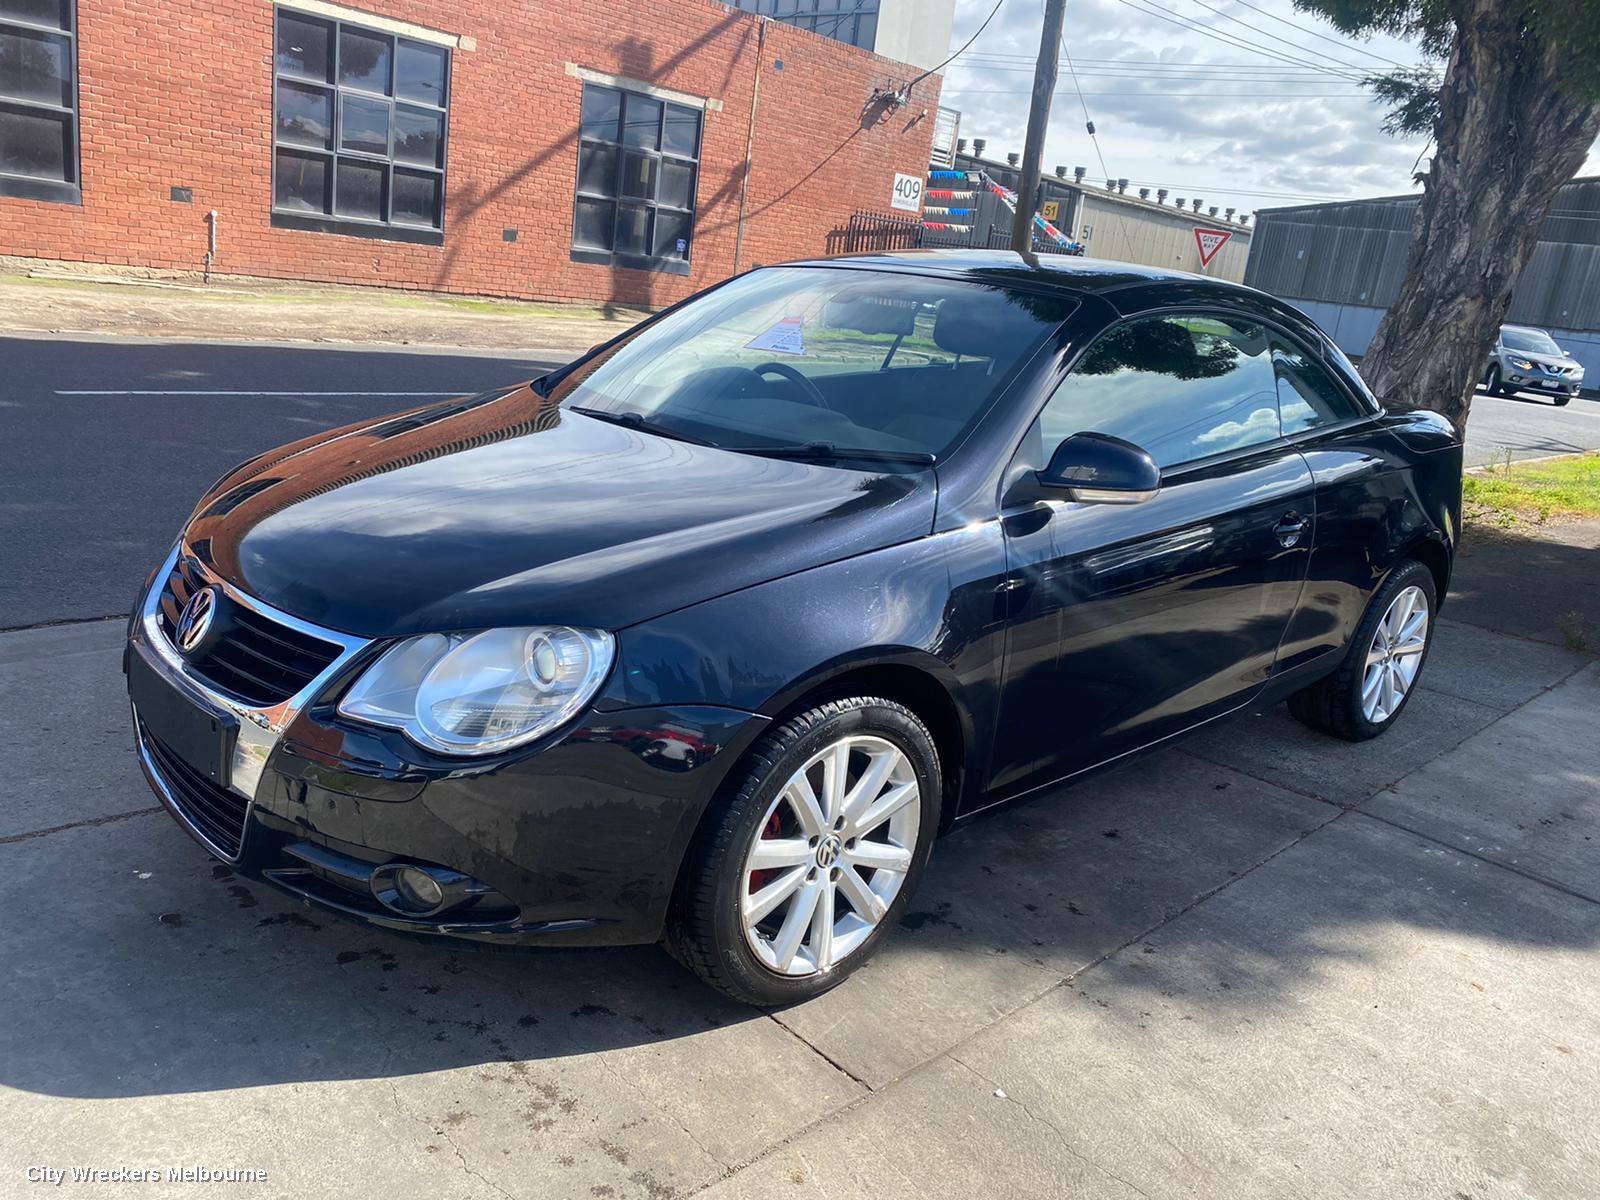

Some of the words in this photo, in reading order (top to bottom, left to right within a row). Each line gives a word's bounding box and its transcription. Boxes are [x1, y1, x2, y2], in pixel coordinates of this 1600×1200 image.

[895, 178, 920, 200] 409
[1045, 205, 1056, 217] 51
[1082, 225, 1093, 240] 51
[1202, 235, 1219, 244] GIVE
